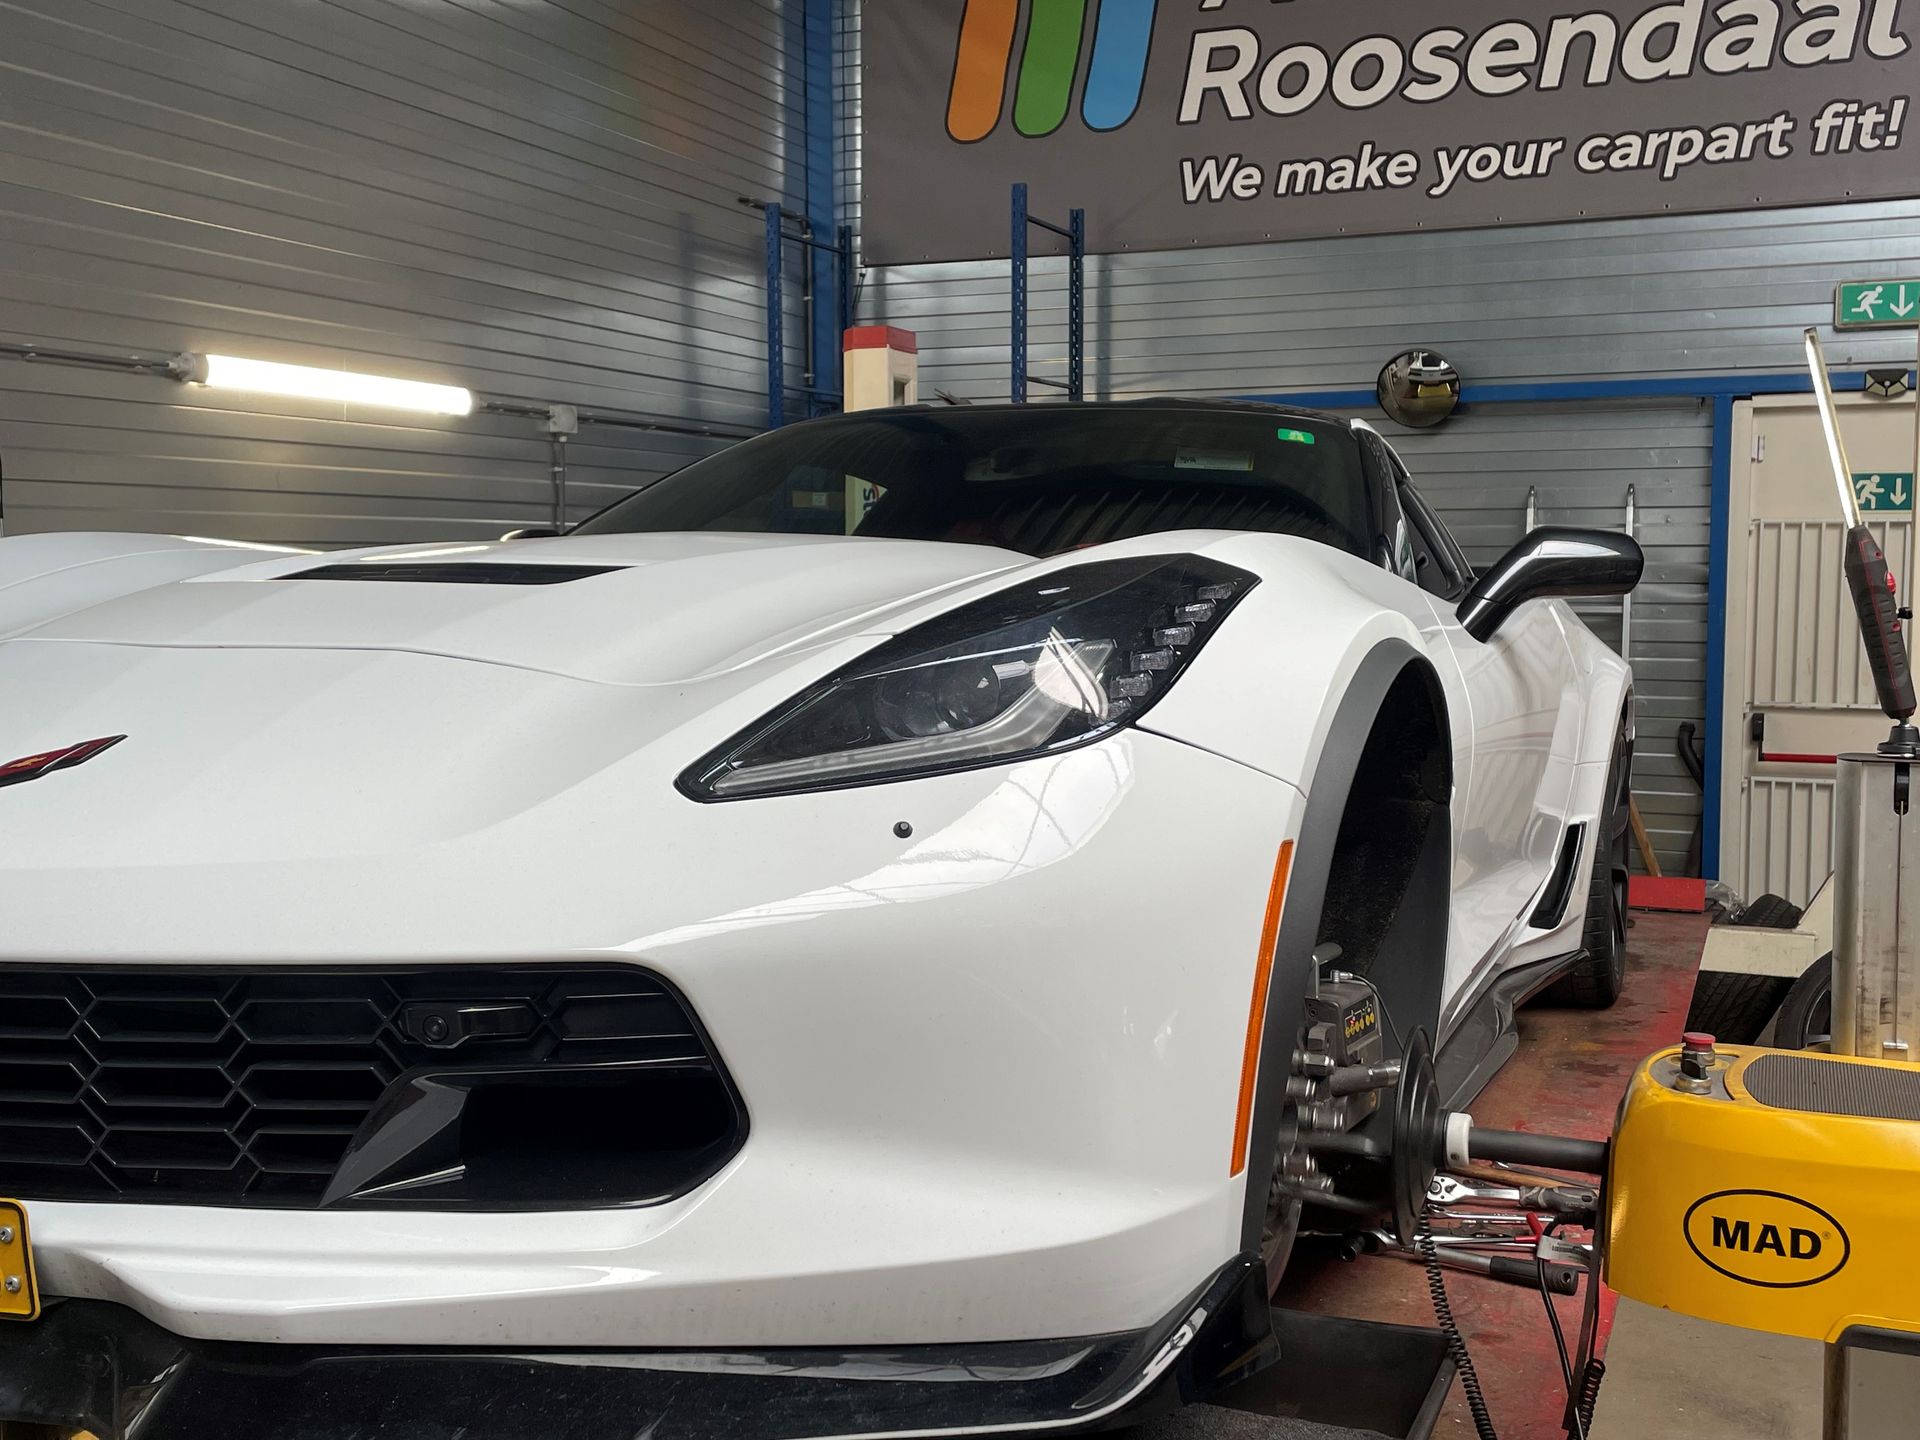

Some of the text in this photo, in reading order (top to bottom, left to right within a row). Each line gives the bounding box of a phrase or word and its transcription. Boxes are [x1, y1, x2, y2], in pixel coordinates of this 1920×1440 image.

[1178, 0, 1908, 122] Roosendaal
[1181, 98, 1907, 201] We make your carpart fit!
[1711, 1215, 1822, 1260] MAD
